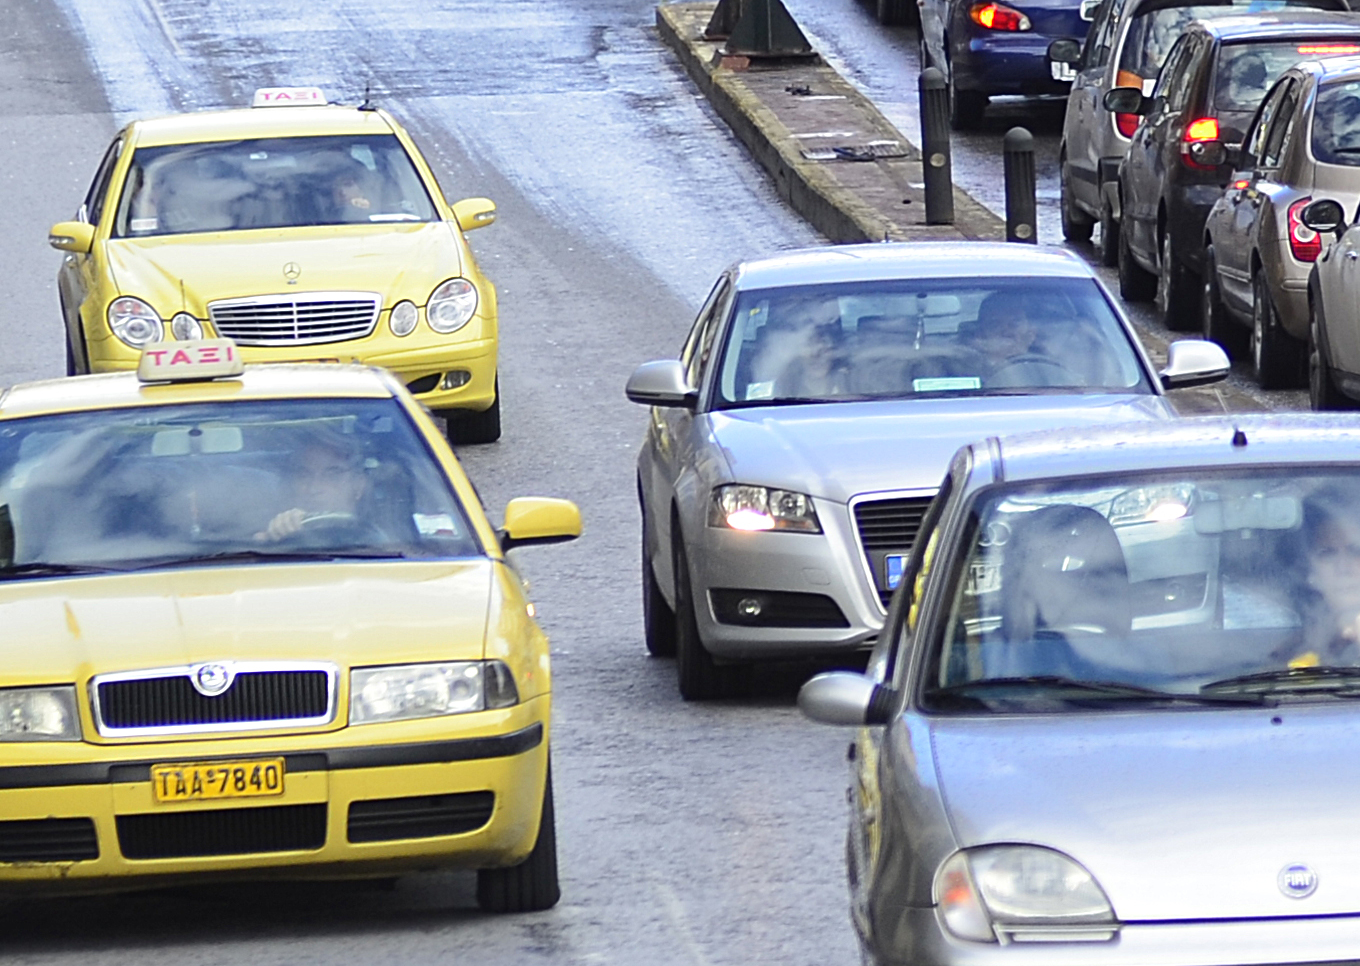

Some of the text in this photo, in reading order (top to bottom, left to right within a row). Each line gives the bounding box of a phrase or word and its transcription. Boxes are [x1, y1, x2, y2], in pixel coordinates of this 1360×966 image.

[259, 92, 319, 102] ΤΑΞΙ
[146, 346, 233, 367] ΤΑΞΙ
[1284, 873, 1311, 886] FIAT
